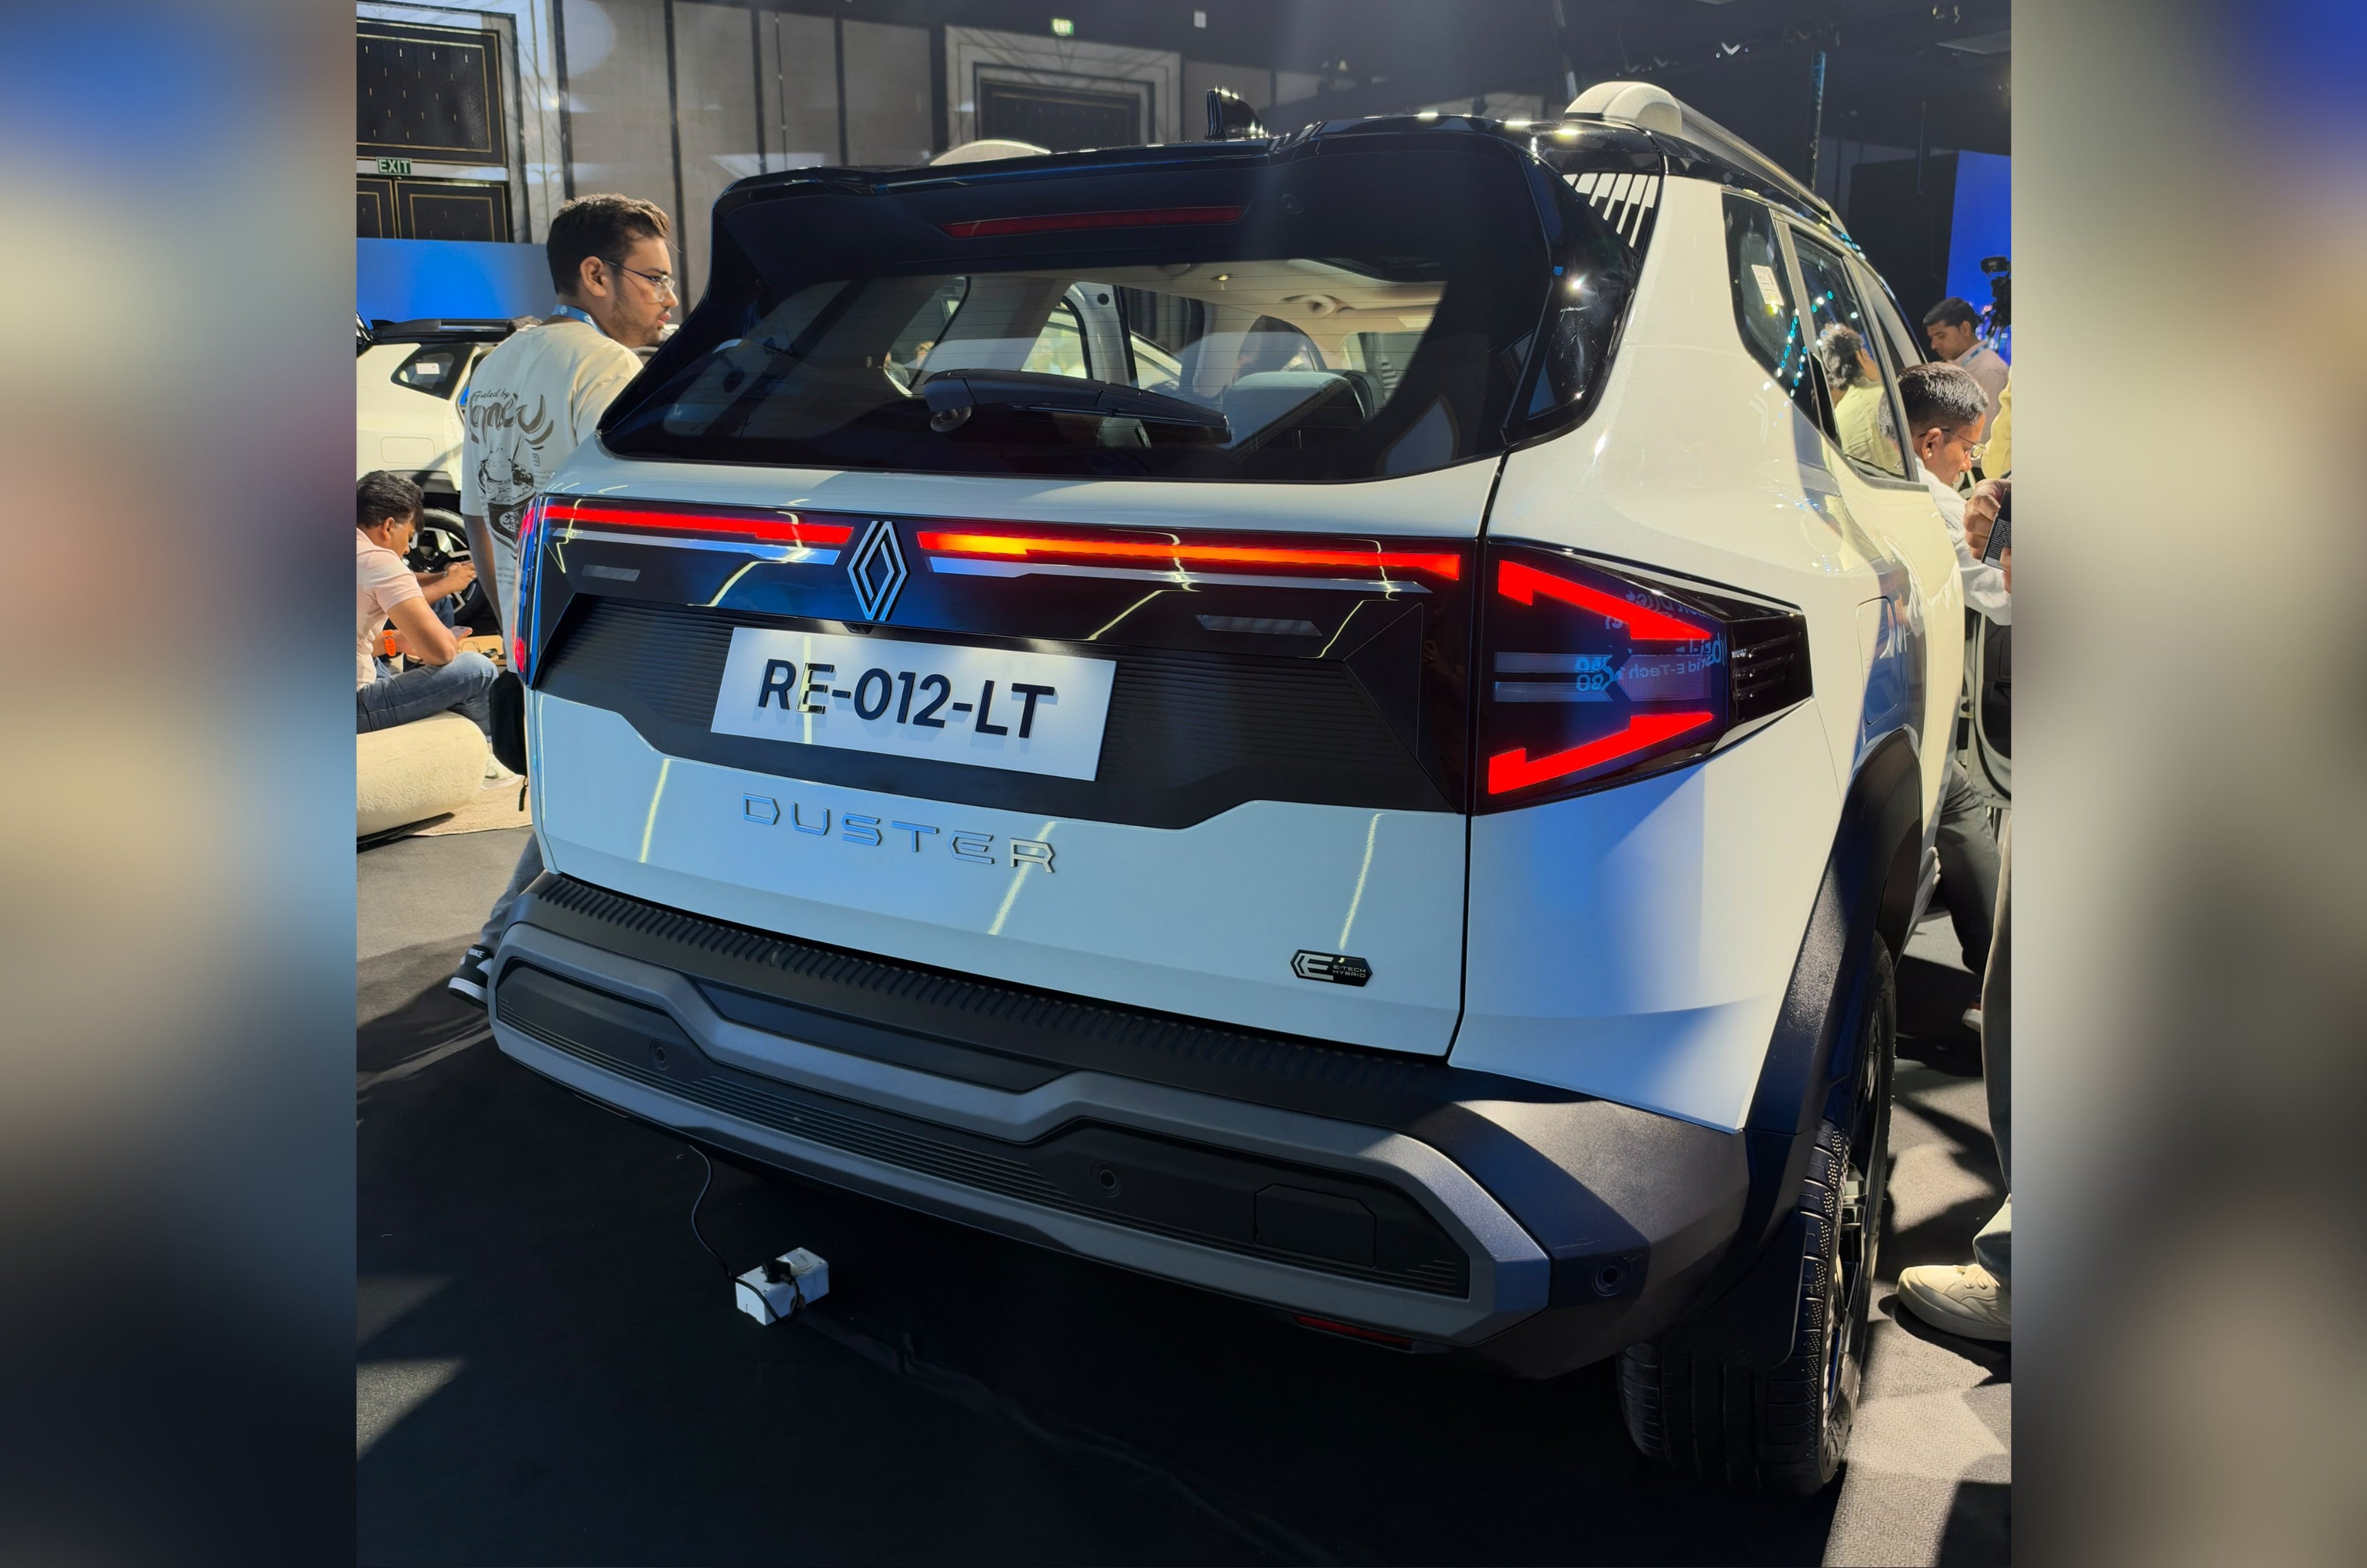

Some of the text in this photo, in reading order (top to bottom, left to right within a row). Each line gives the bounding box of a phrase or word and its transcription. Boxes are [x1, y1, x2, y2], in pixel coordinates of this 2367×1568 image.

[379, 159, 410, 173] EXIT
[474, 388, 509, 400] Fueled by
[758, 658, 1055, 739] RE-012-LT
[742, 793, 1056, 874] DUSTER
[1332, 965, 1366, 973] E-TECH
[1332, 970, 1366, 978] HYBRID
